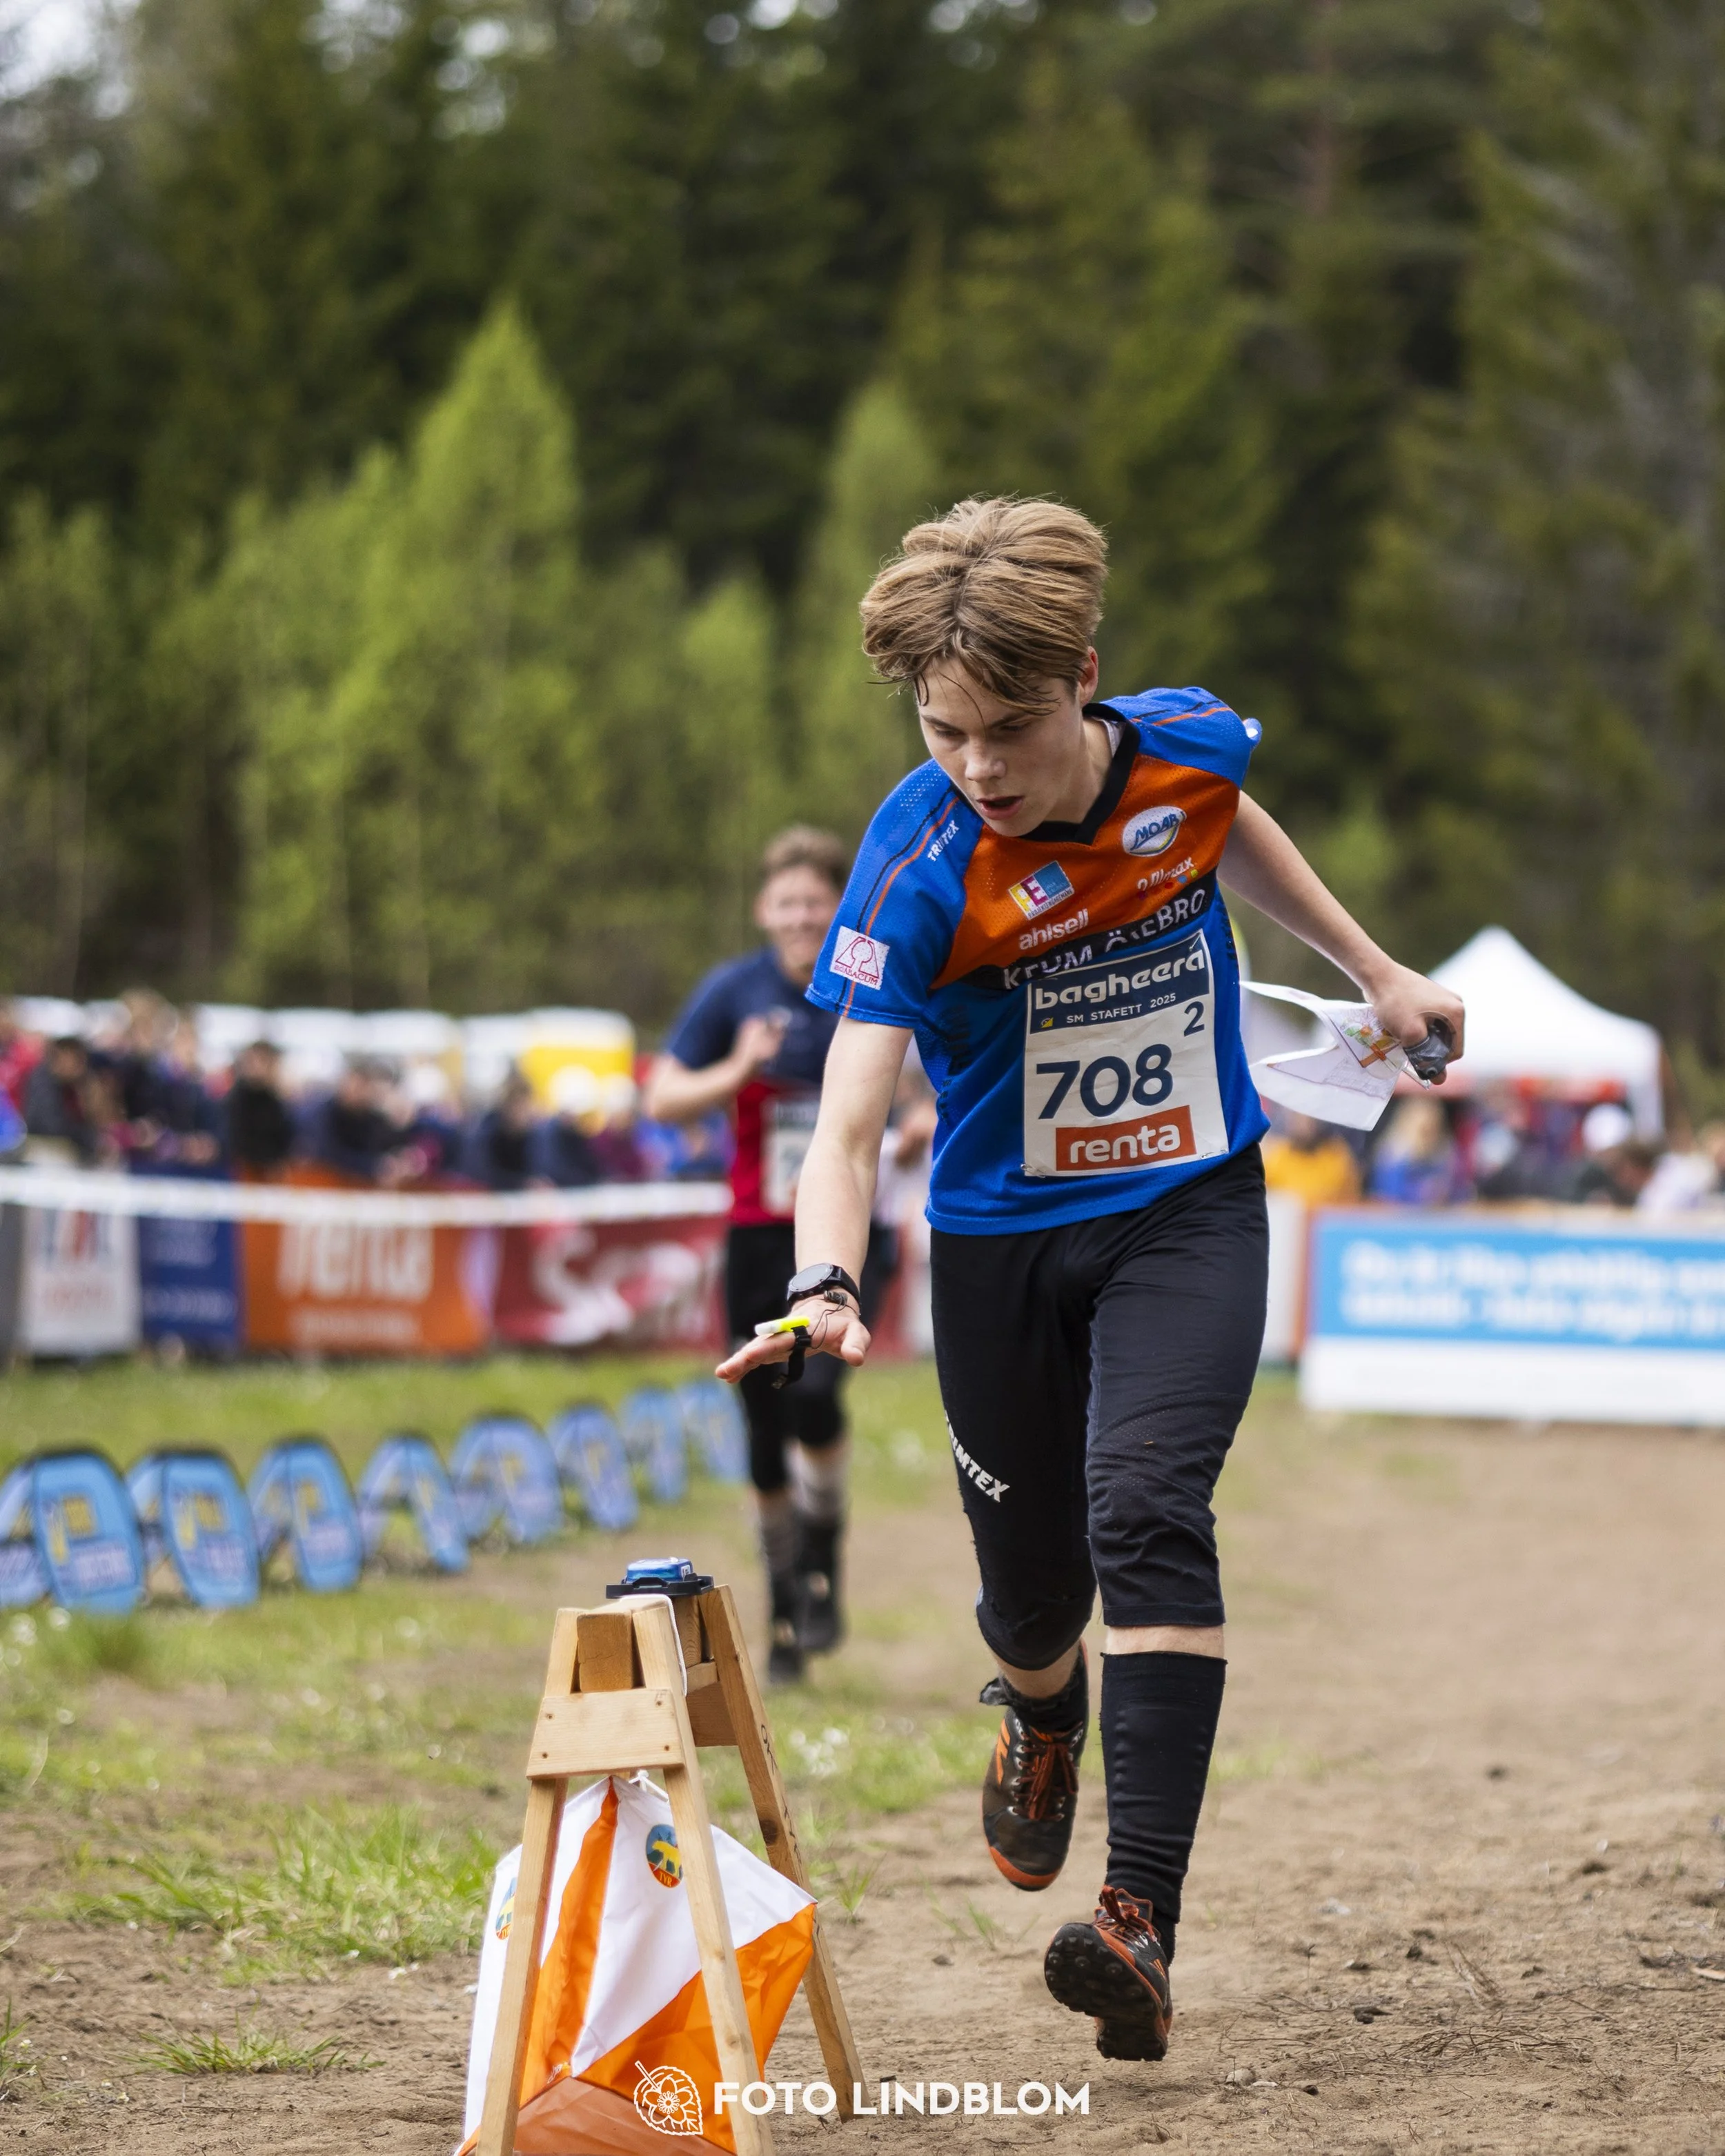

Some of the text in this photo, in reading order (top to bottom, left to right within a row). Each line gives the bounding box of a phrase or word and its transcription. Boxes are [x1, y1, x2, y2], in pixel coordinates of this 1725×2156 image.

[1018, 908, 1089, 950] ahlsell
[1106, 889, 1205, 952] ÖEBRO
[1036, 949, 1205, 1009] bagheera
[1067, 993, 1176, 1024] SM STAFETT 2025
[1183, 1000, 1205, 1037] 2
[1036, 1044, 1173, 1119] 708
[1070, 1124, 1181, 1164] renta
[660, 1870, 673, 1887] TYR
